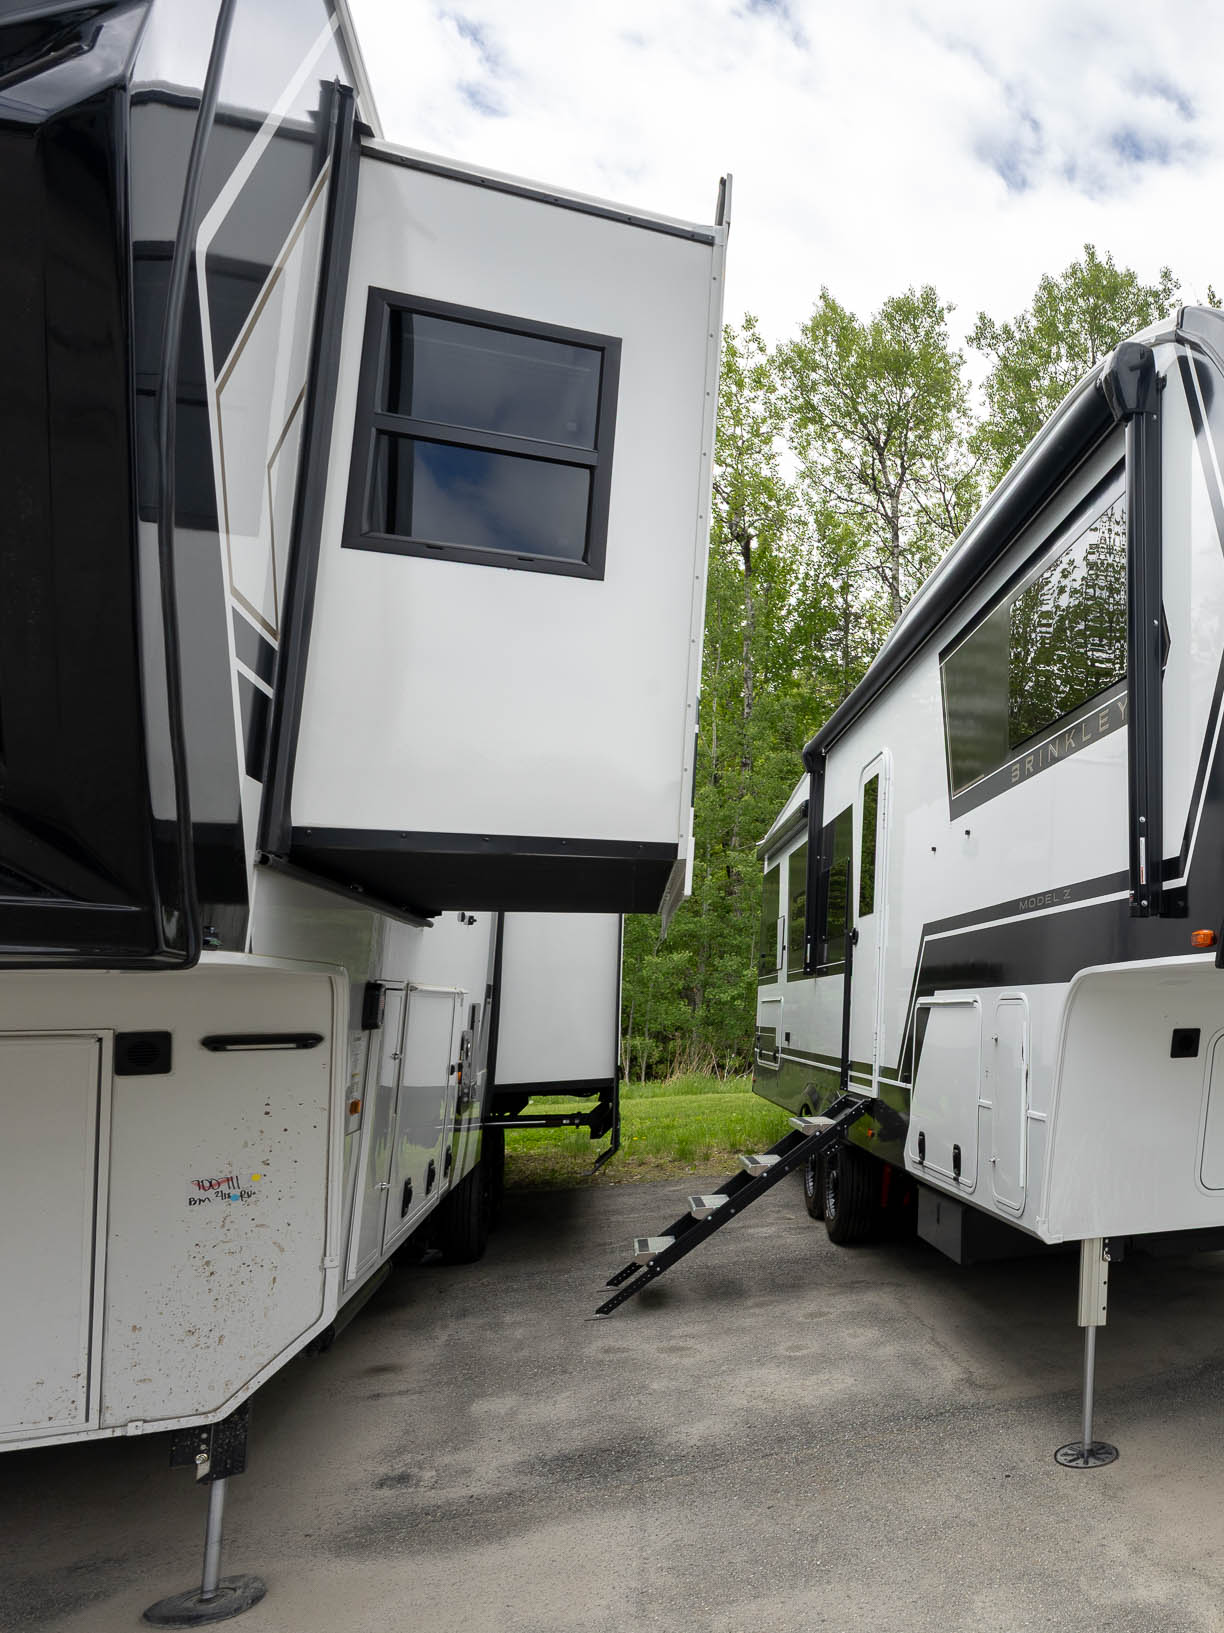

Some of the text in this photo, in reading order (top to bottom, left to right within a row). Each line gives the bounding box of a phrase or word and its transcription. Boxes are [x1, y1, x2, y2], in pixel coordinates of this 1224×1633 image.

[1011, 696, 1128, 784] BRINKLEY
[1019, 888, 1072, 912] MODEL Z
